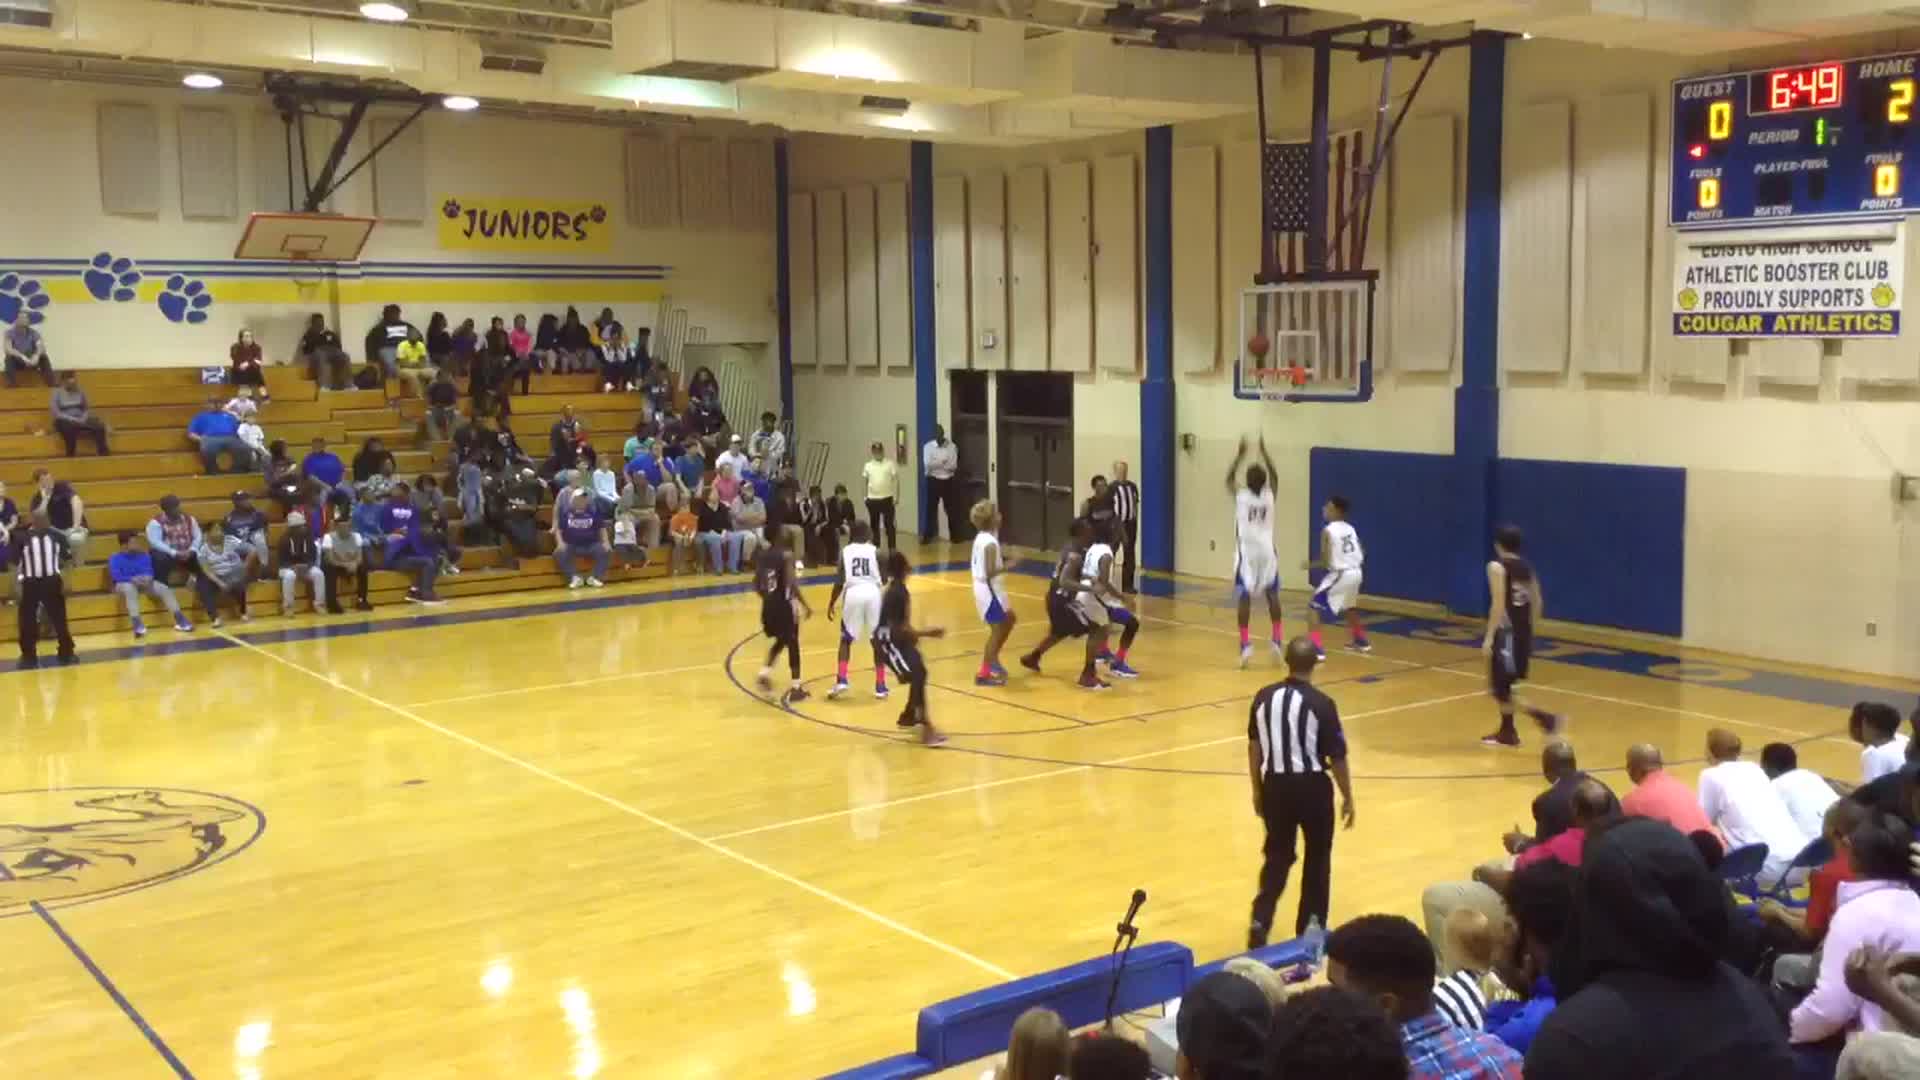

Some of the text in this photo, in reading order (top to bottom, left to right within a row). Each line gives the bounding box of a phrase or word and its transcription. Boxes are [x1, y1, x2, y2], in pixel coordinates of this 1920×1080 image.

[1859, 58, 1915, 78] HOME
[1680, 79, 1736, 99] GUEST
[1771, 67, 1839, 109] 6:49
[1888, 80, 1914, 122] 2
[1709, 102, 1731, 140] 0
[1748, 129, 1799, 145] PERIOD
[1876, 165, 1898, 196] 0
[1699, 179, 1720, 208] 0
[1860, 198, 1903, 211] POINTS
[463, 209, 590, 241] JUNIORS
[1686, 260, 1888, 284] ATHLETIC BOOSTER CLUB
[1703, 288, 1864, 309] PROUDLY SUPPORTS
[1680, 313, 1893, 332] COUGAR ATHLETICS
